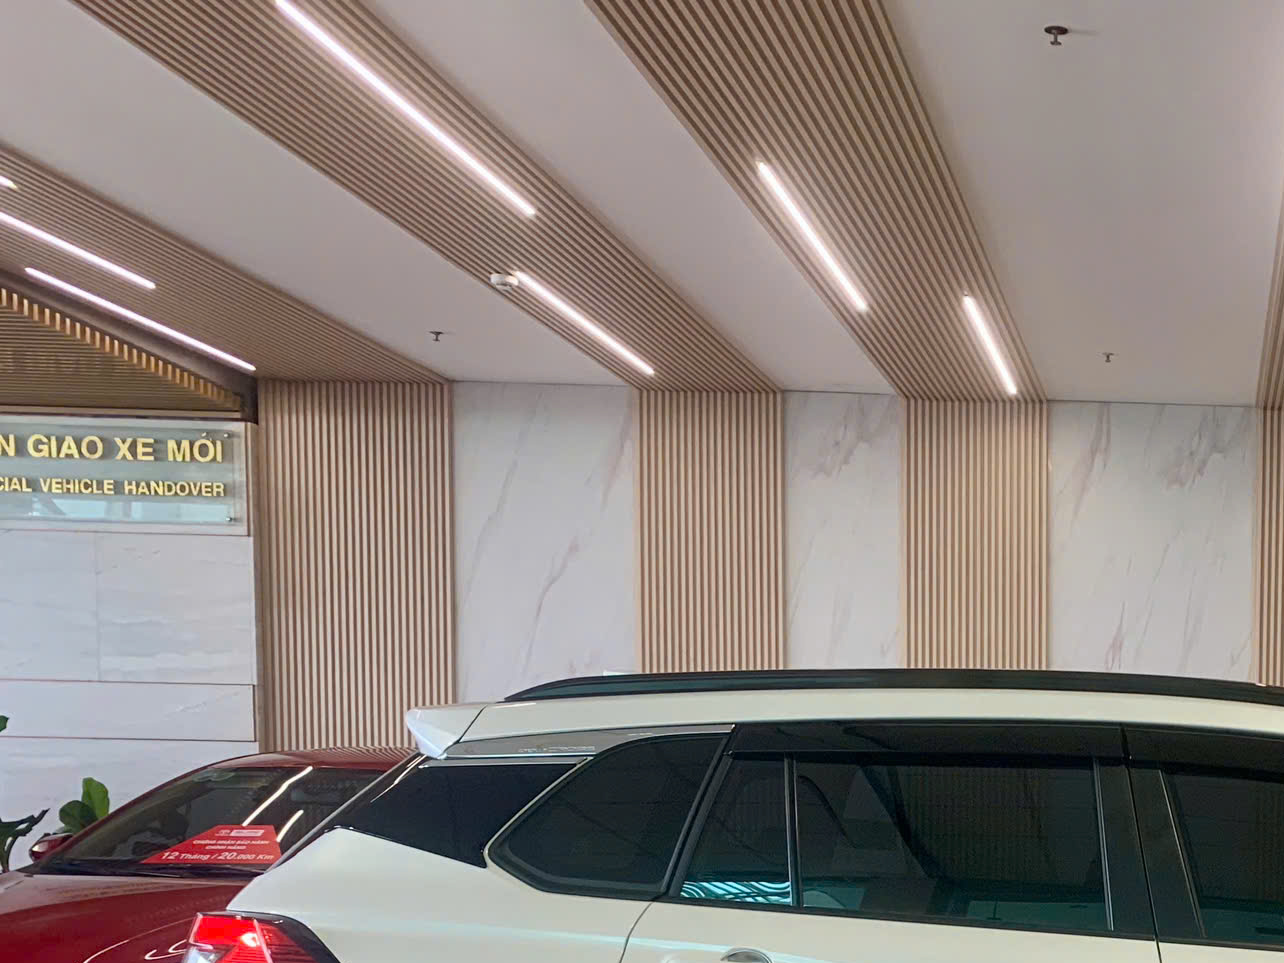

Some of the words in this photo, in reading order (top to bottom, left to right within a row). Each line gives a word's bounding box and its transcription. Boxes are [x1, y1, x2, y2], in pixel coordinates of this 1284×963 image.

[27, 434, 103, 459] GIAO
[114, 437, 154, 461] XE
[168, 432, 222, 463] MỚI
[40, 478, 114, 494] VEHICLE
[124, 480, 224, 496] HANDOVER
[161, 851, 179, 859] 12
